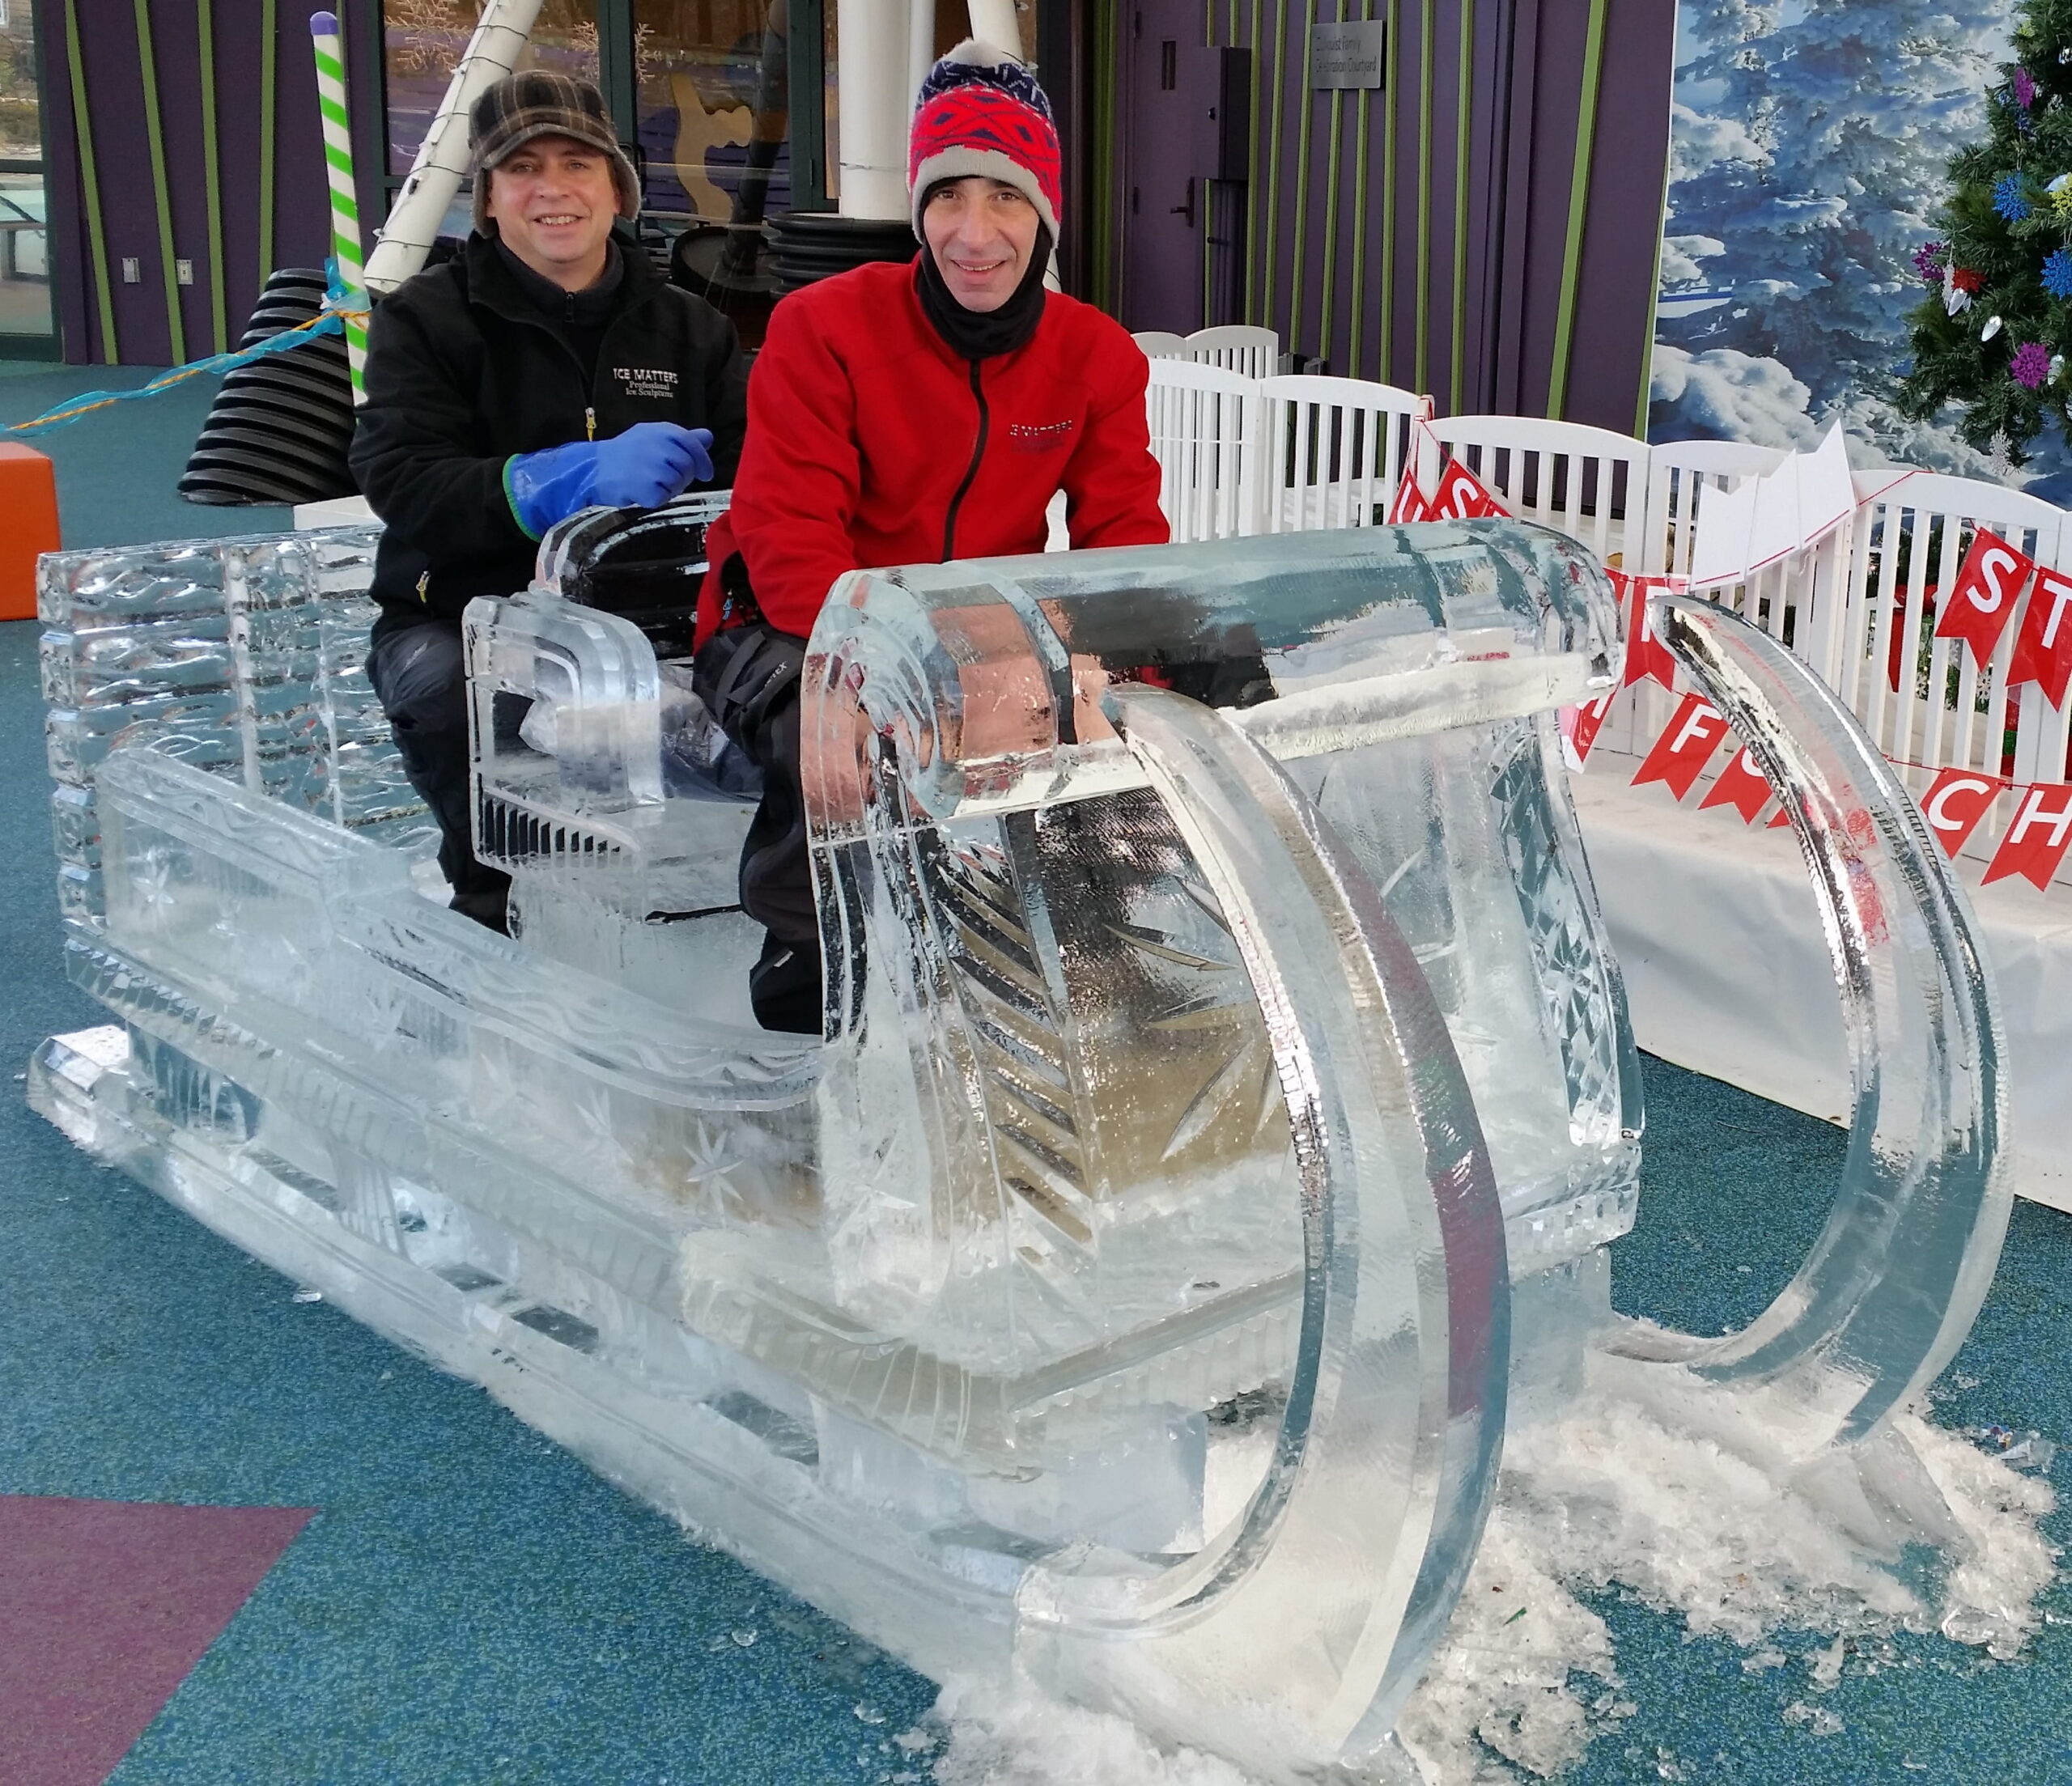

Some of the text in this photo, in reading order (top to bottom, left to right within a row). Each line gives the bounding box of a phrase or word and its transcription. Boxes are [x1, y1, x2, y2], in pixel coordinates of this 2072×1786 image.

[1348, 55, 1377, 76] Courtyard
[613, 367, 678, 384] ICE MATTERS
[626, 388, 637, 396] Ice
